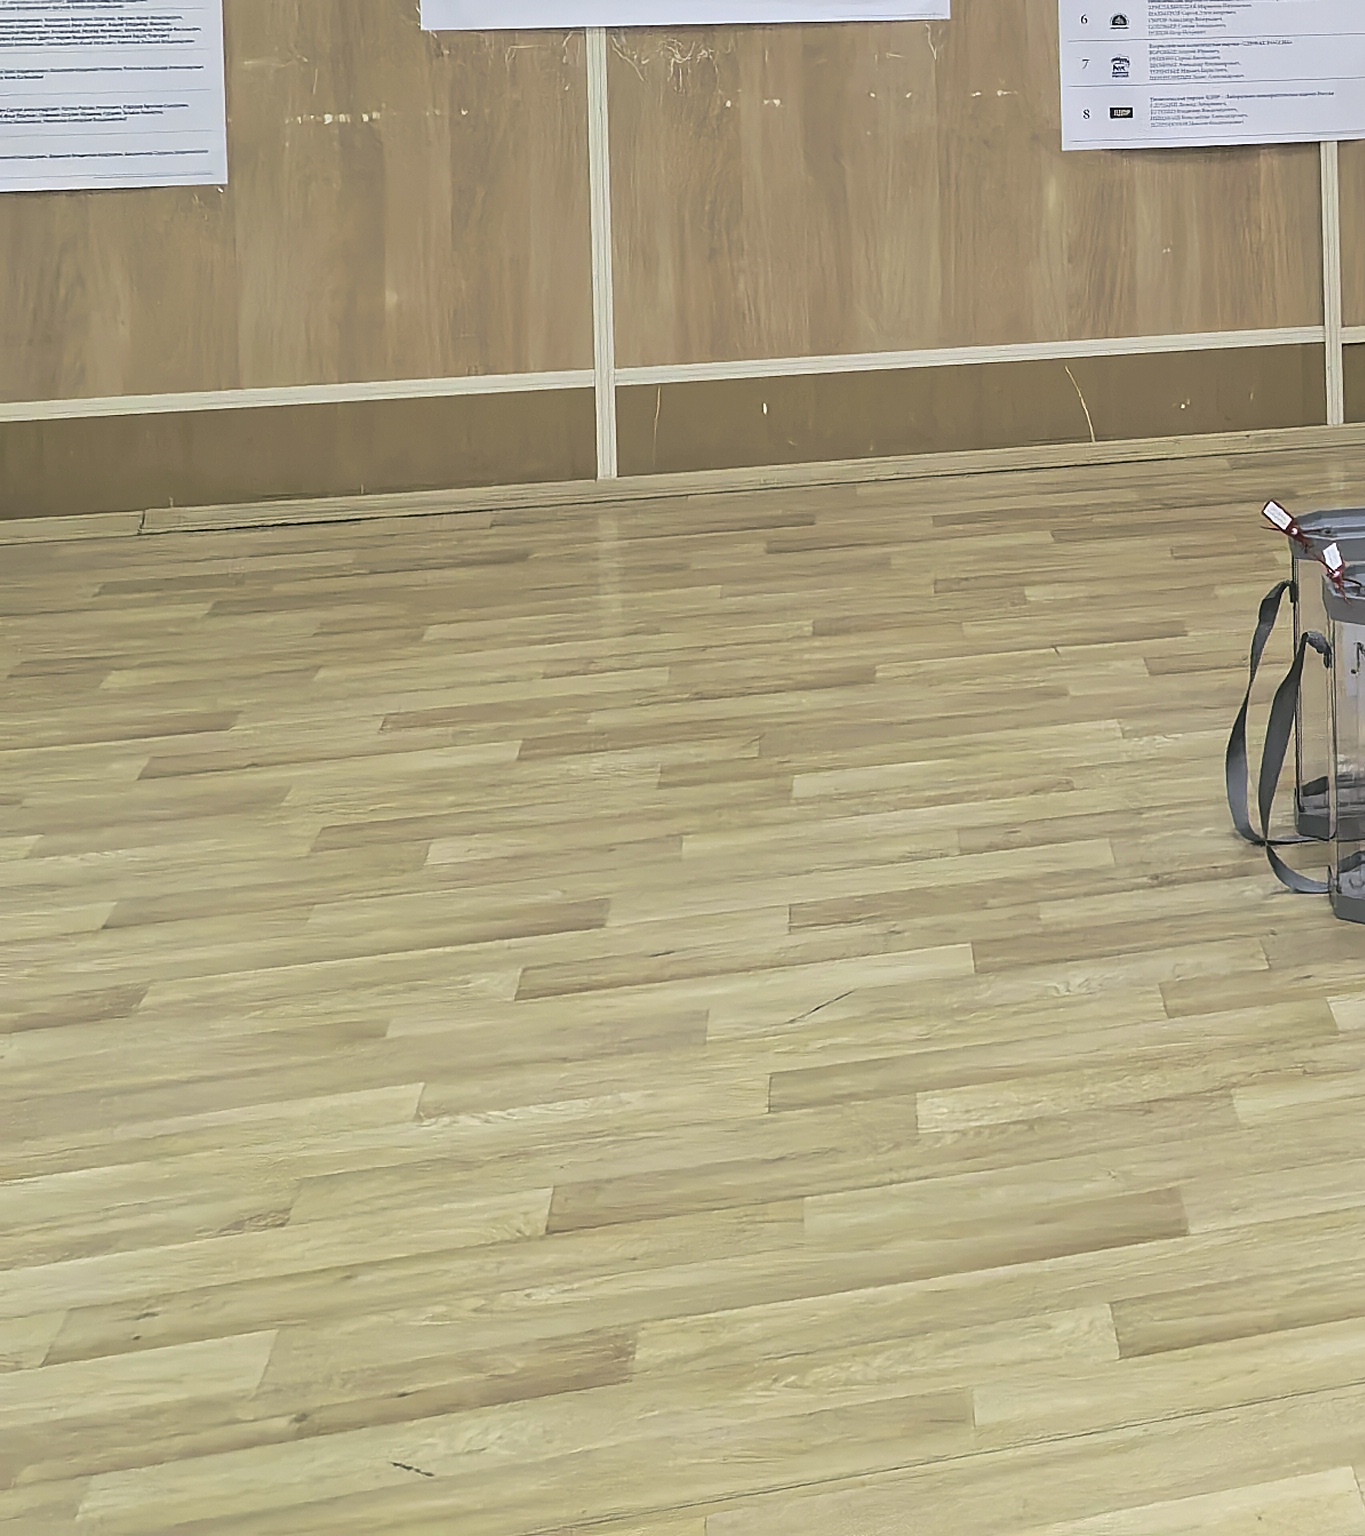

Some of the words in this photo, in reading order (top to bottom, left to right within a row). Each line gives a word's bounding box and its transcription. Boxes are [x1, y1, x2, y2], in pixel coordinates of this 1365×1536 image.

[1080, 14, 1088, 24] 6
[1081, 59, 1090, 69] 7
[1083, 109, 1090, 119] 8
